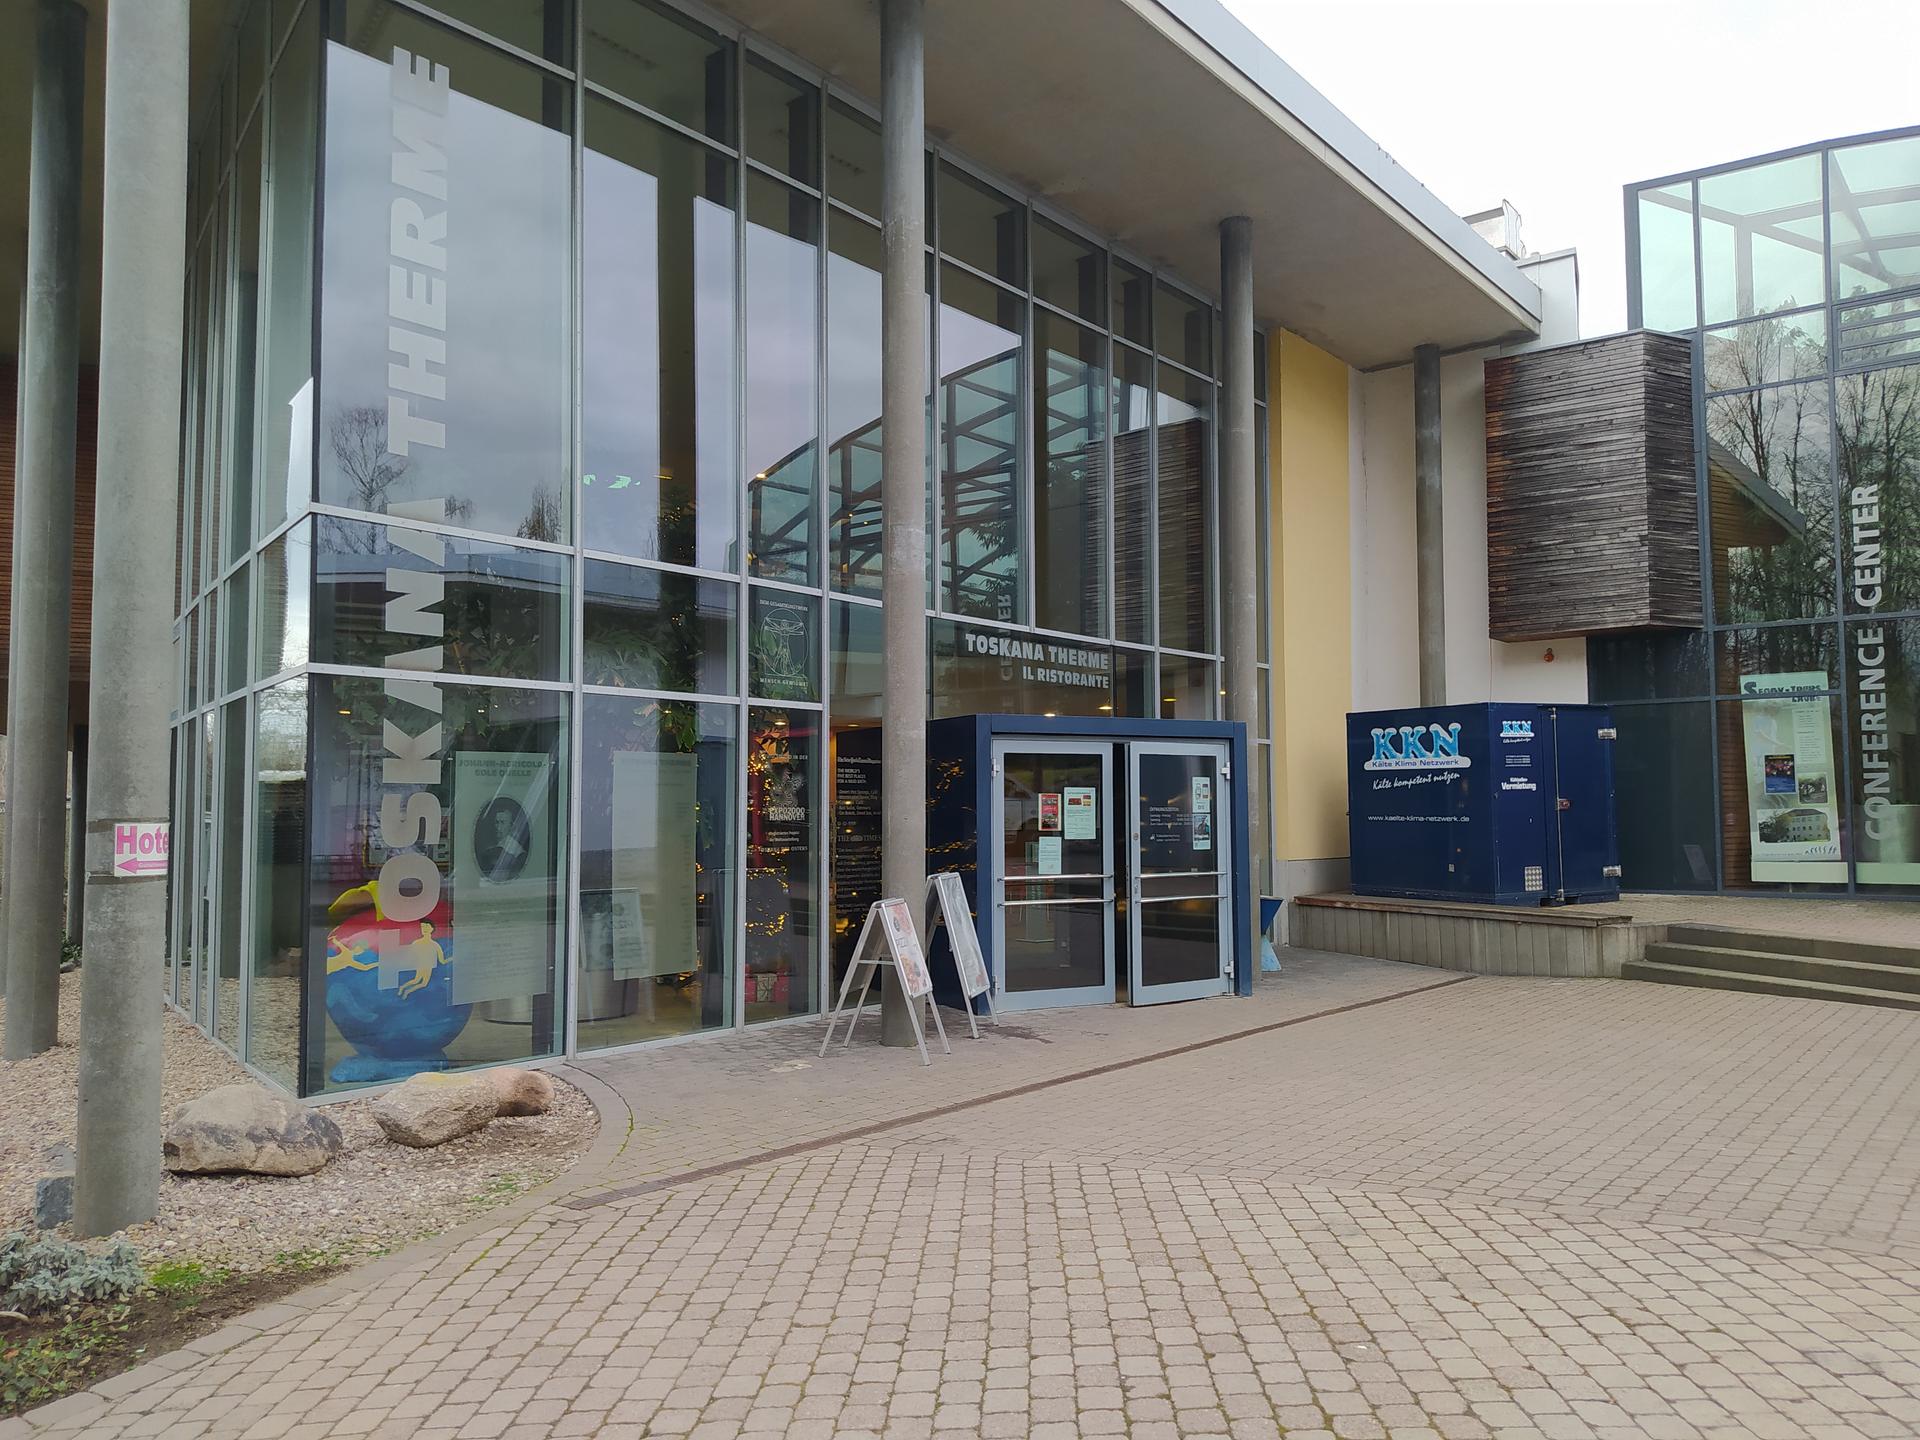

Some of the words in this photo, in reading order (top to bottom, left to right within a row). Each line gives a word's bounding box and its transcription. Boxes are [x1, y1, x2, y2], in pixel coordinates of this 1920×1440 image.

[387, 45, 450, 457] THERME
[1851, 483, 1883, 607] CENTER
[965, 633, 1045, 662] TOSKANA
[1049, 646, 1108, 670] THERME
[1023, 665, 1034, 680] IL
[1037, 667, 1109, 689] RISTORANTE
[377, 497, 446, 991] TOSKANA
[1371, 722, 1462, 760] KKN
[1502, 720, 1532, 733] KKN
[1857, 626, 1891, 841] CONFERENCE
[1372, 760, 1393, 768] Kälte
[1420, 759, 1460, 767] Netzwerk
[1373, 777, 1392, 790] Kälte
[1393, 773, 1432, 789] kompetent
[1433, 770, 1460, 784] nutzen
[1501, 782, 1537, 791] Vermietung
